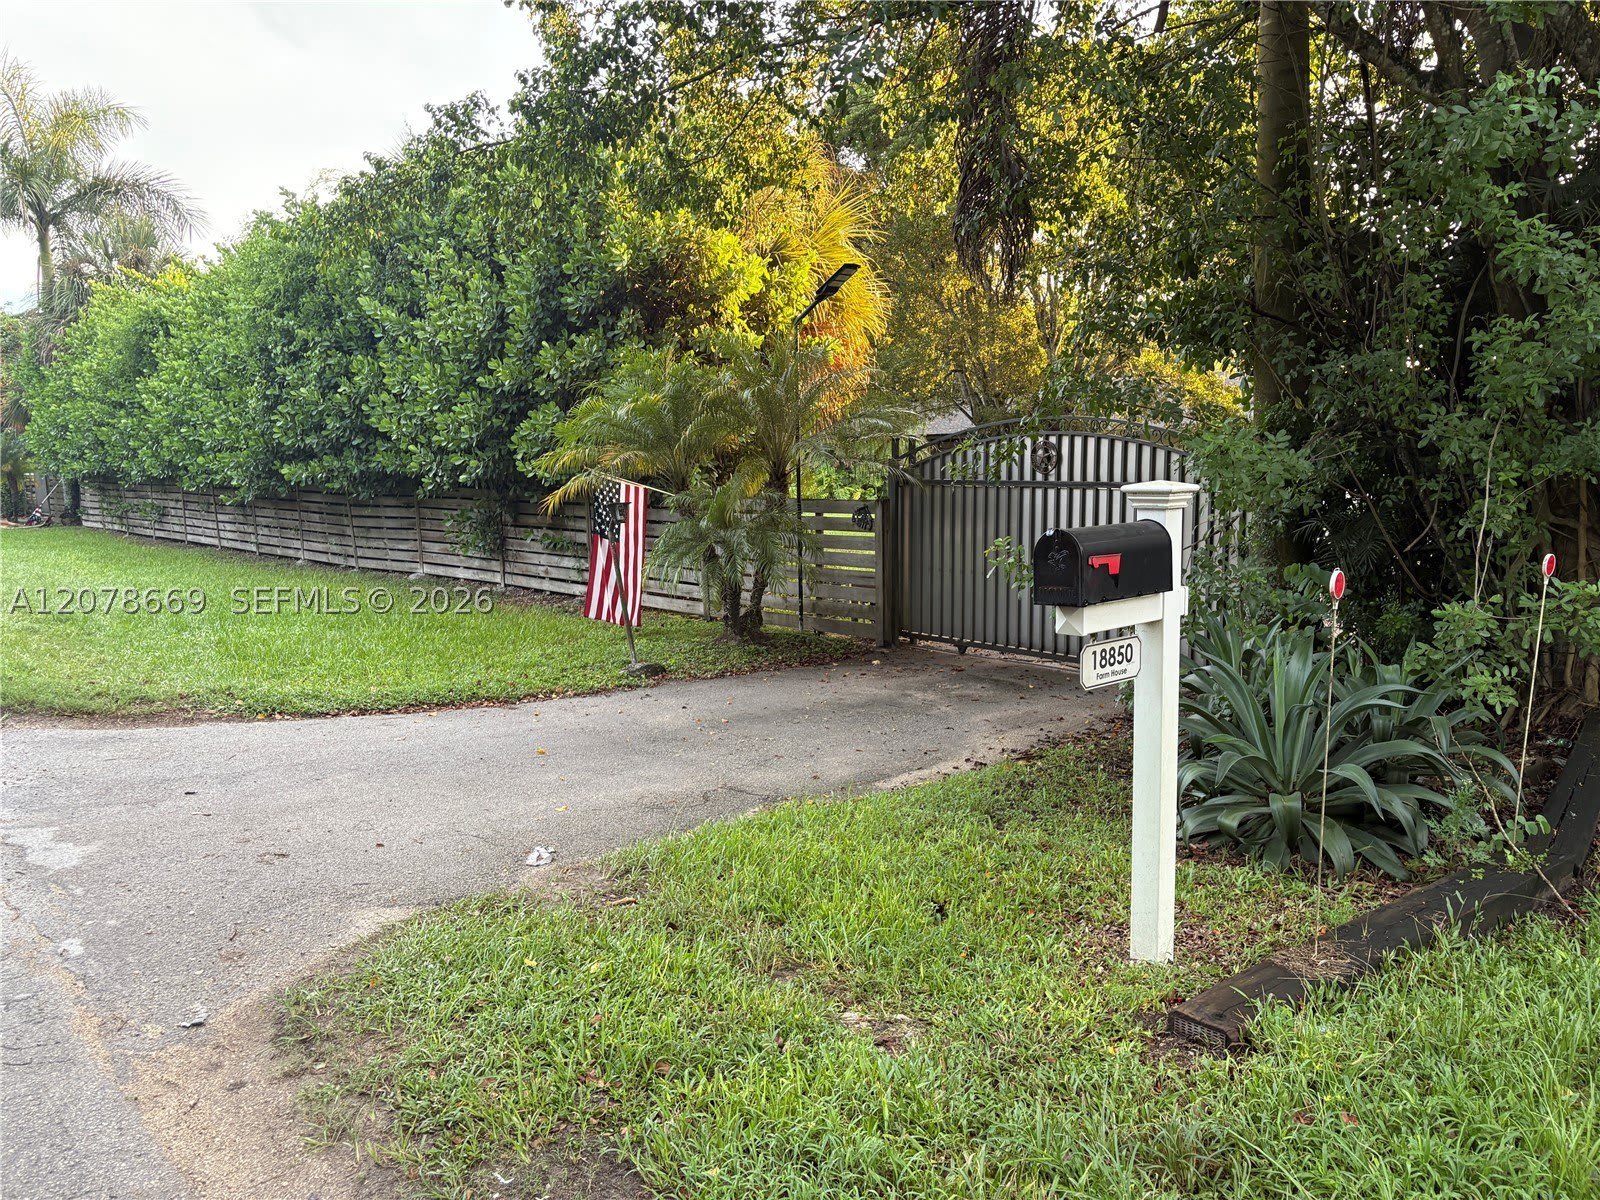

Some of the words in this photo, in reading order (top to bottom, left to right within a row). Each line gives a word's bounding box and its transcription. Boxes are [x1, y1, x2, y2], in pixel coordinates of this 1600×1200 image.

[1092, 643, 1133, 670] 18850
[1096, 672, 1110, 680] Farm
[1111, 668, 1128, 677] House
